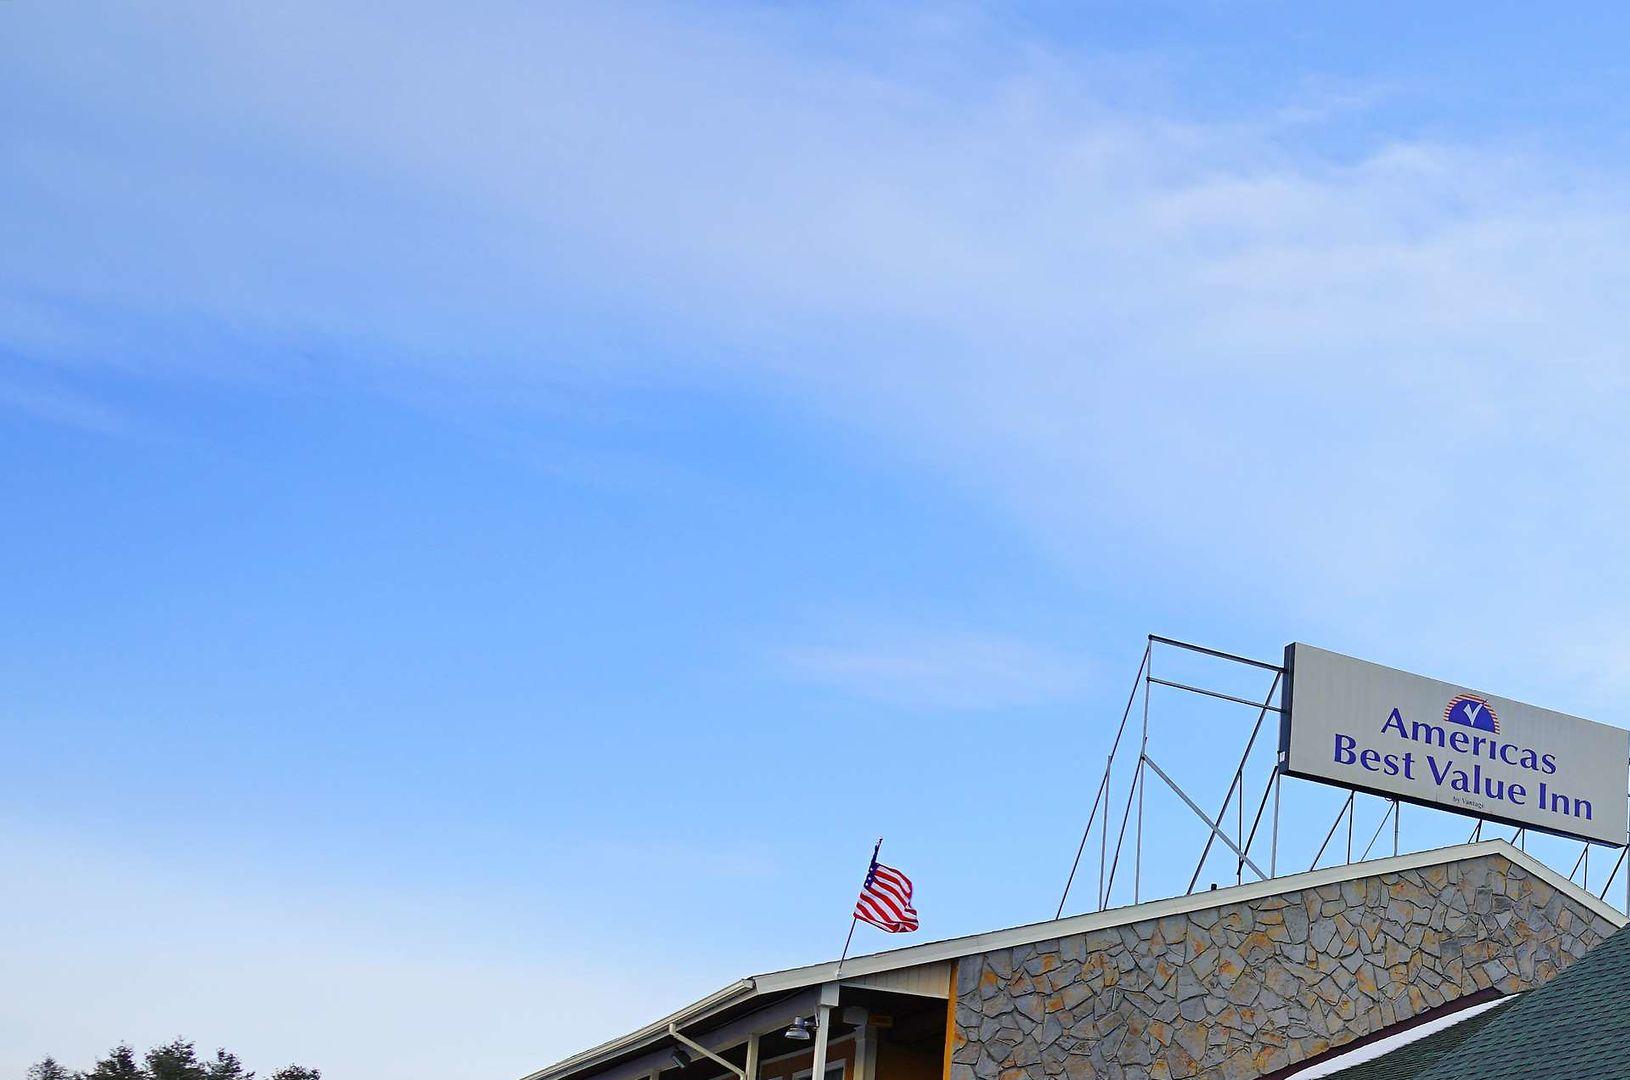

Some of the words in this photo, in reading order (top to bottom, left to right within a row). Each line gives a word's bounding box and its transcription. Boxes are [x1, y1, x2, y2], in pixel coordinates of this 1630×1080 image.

[1333, 733, 1416, 780] Best
[1426, 755, 1527, 805] Value
[1538, 783, 1593, 821] Inn
[1381, 707, 1558, 775] Americas
